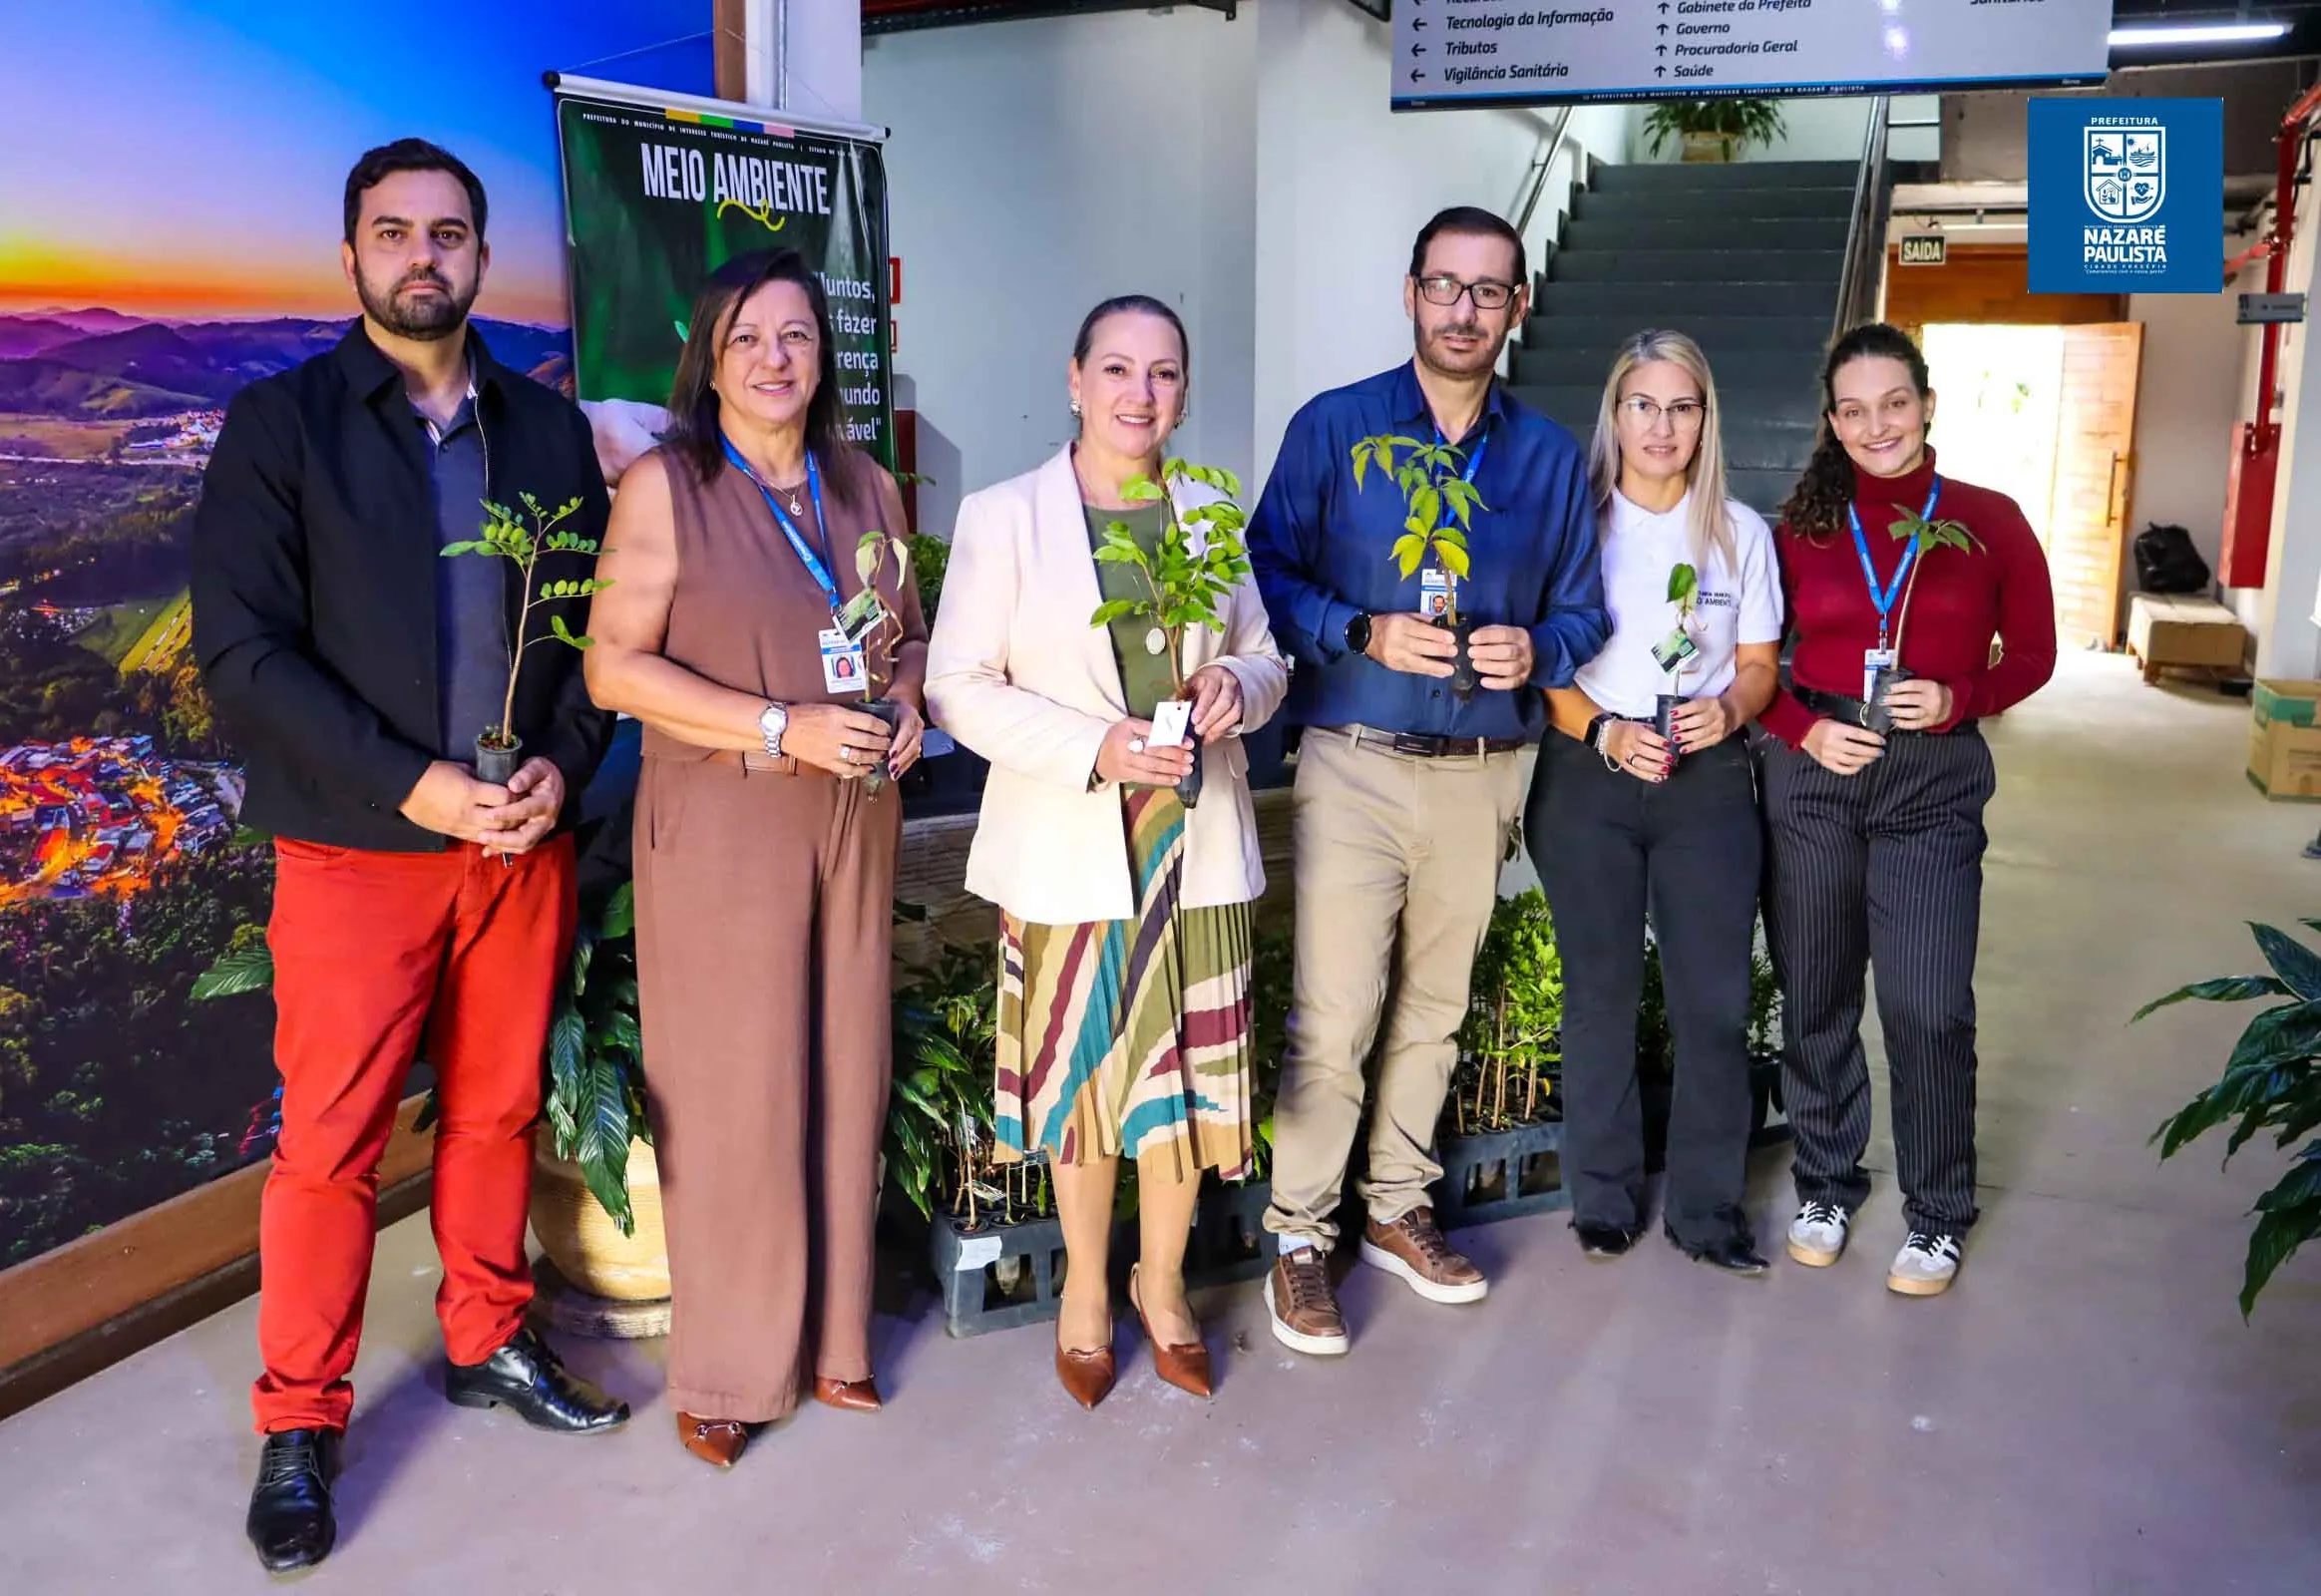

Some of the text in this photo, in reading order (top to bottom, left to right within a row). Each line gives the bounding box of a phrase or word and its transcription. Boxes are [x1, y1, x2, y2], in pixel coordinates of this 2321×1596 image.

[1678, 1, 1736, 14] Gabinete
[1739, 0, 1754, 11] da
[1446, 8, 1614, 31] Tecnologia da Informação
[1676, 23, 1731, 36] Governo
[1446, 41, 1497, 56] Tributos
[1675, 40, 1797, 57] Procuradoria Geral
[1444, 63, 1569, 85] Vigilância Sanitária
[1674, 65, 1714, 78] Saúde
[582, 113, 617, 124] PREFEITURA
[640, 143, 831, 215] MEIO AMBIENTE
[1904, 238, 1941, 261] SAÍDA
[837, 309, 878, 335] fazer
[837, 351, 879, 377] rença
